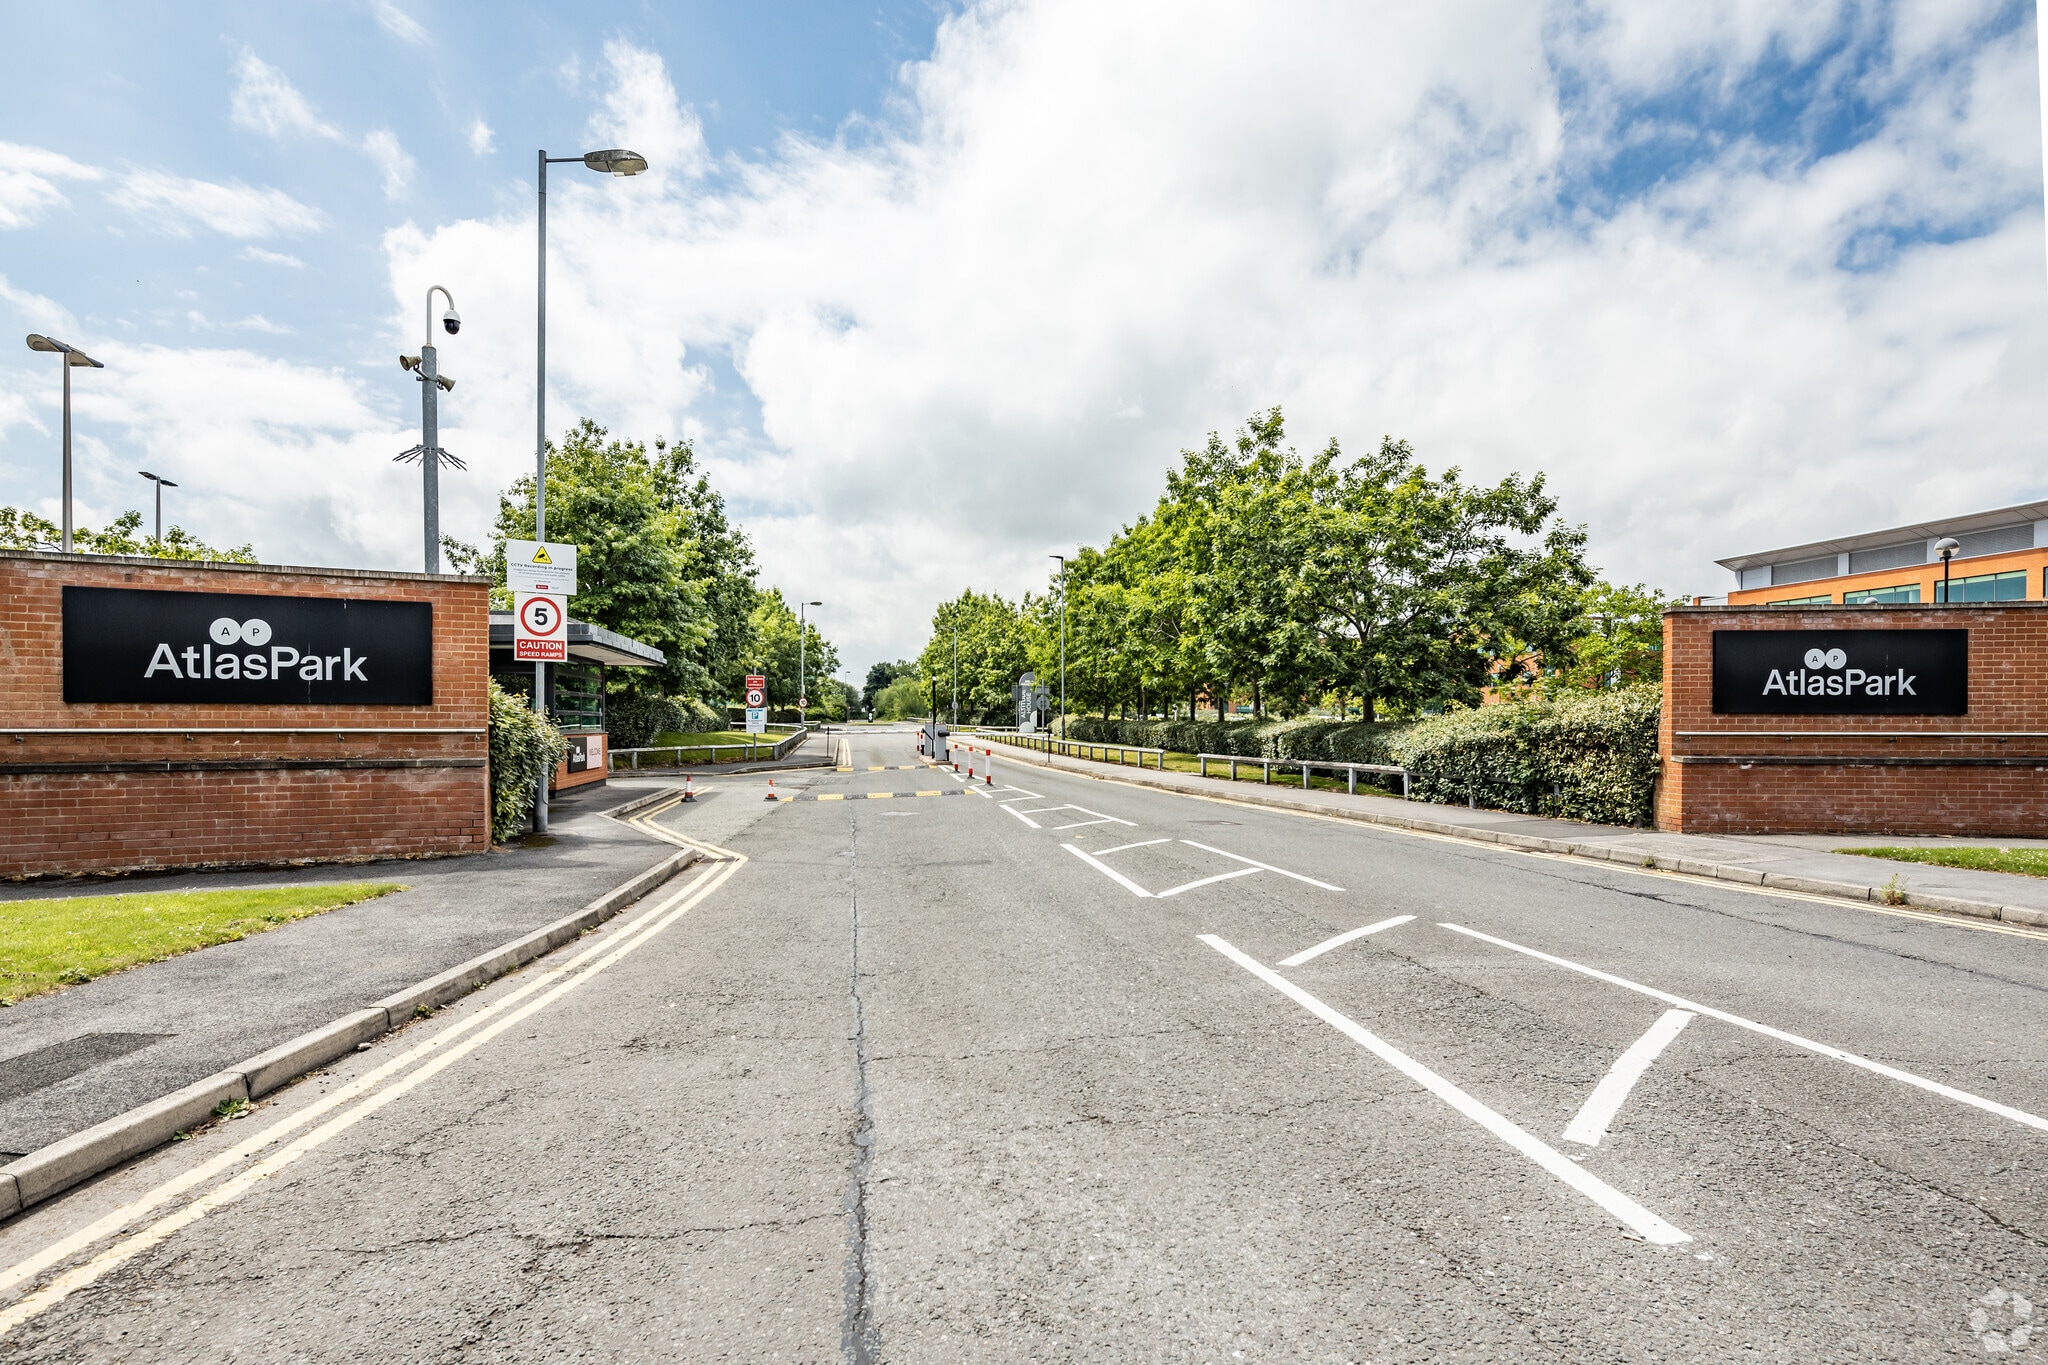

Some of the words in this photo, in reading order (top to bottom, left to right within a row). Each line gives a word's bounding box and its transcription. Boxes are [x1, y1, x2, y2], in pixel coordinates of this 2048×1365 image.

[534, 607, 548, 626] 5
[220, 626, 231, 637] A
[252, 627, 260, 637] P
[520, 640, 562, 650] CAUTION
[143, 643, 369, 682] AtlasPark
[1811, 655, 1819, 663] A
[1833, 655, 1839, 663] P
[1762, 668, 1917, 696] AtlasPark
[750, 694, 760, 702] 10
